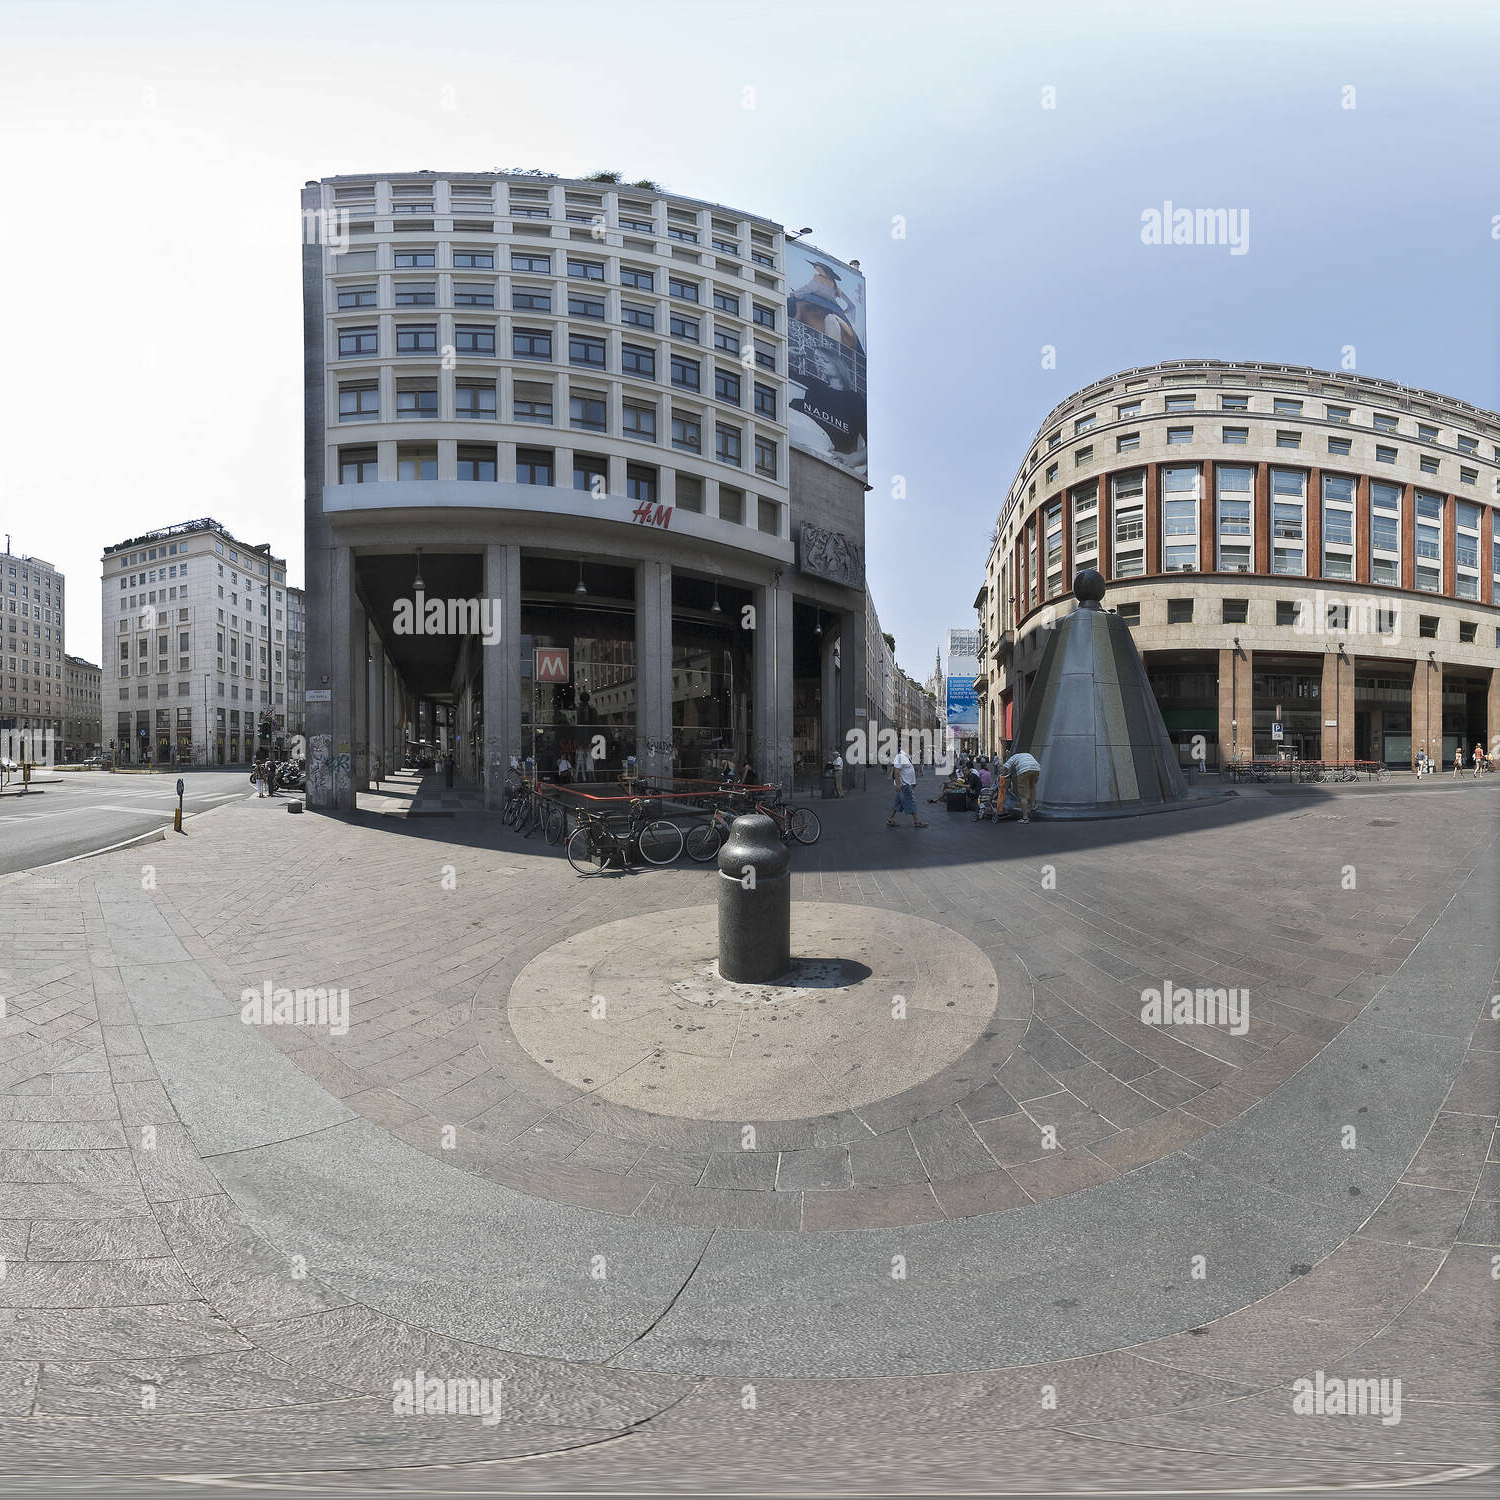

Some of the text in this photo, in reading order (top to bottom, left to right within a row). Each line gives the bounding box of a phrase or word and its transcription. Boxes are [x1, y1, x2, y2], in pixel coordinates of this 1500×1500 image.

[803, 401, 849, 432] NADINE
[632, 501, 673, 529] H&M
[540, 656, 565, 675] M
